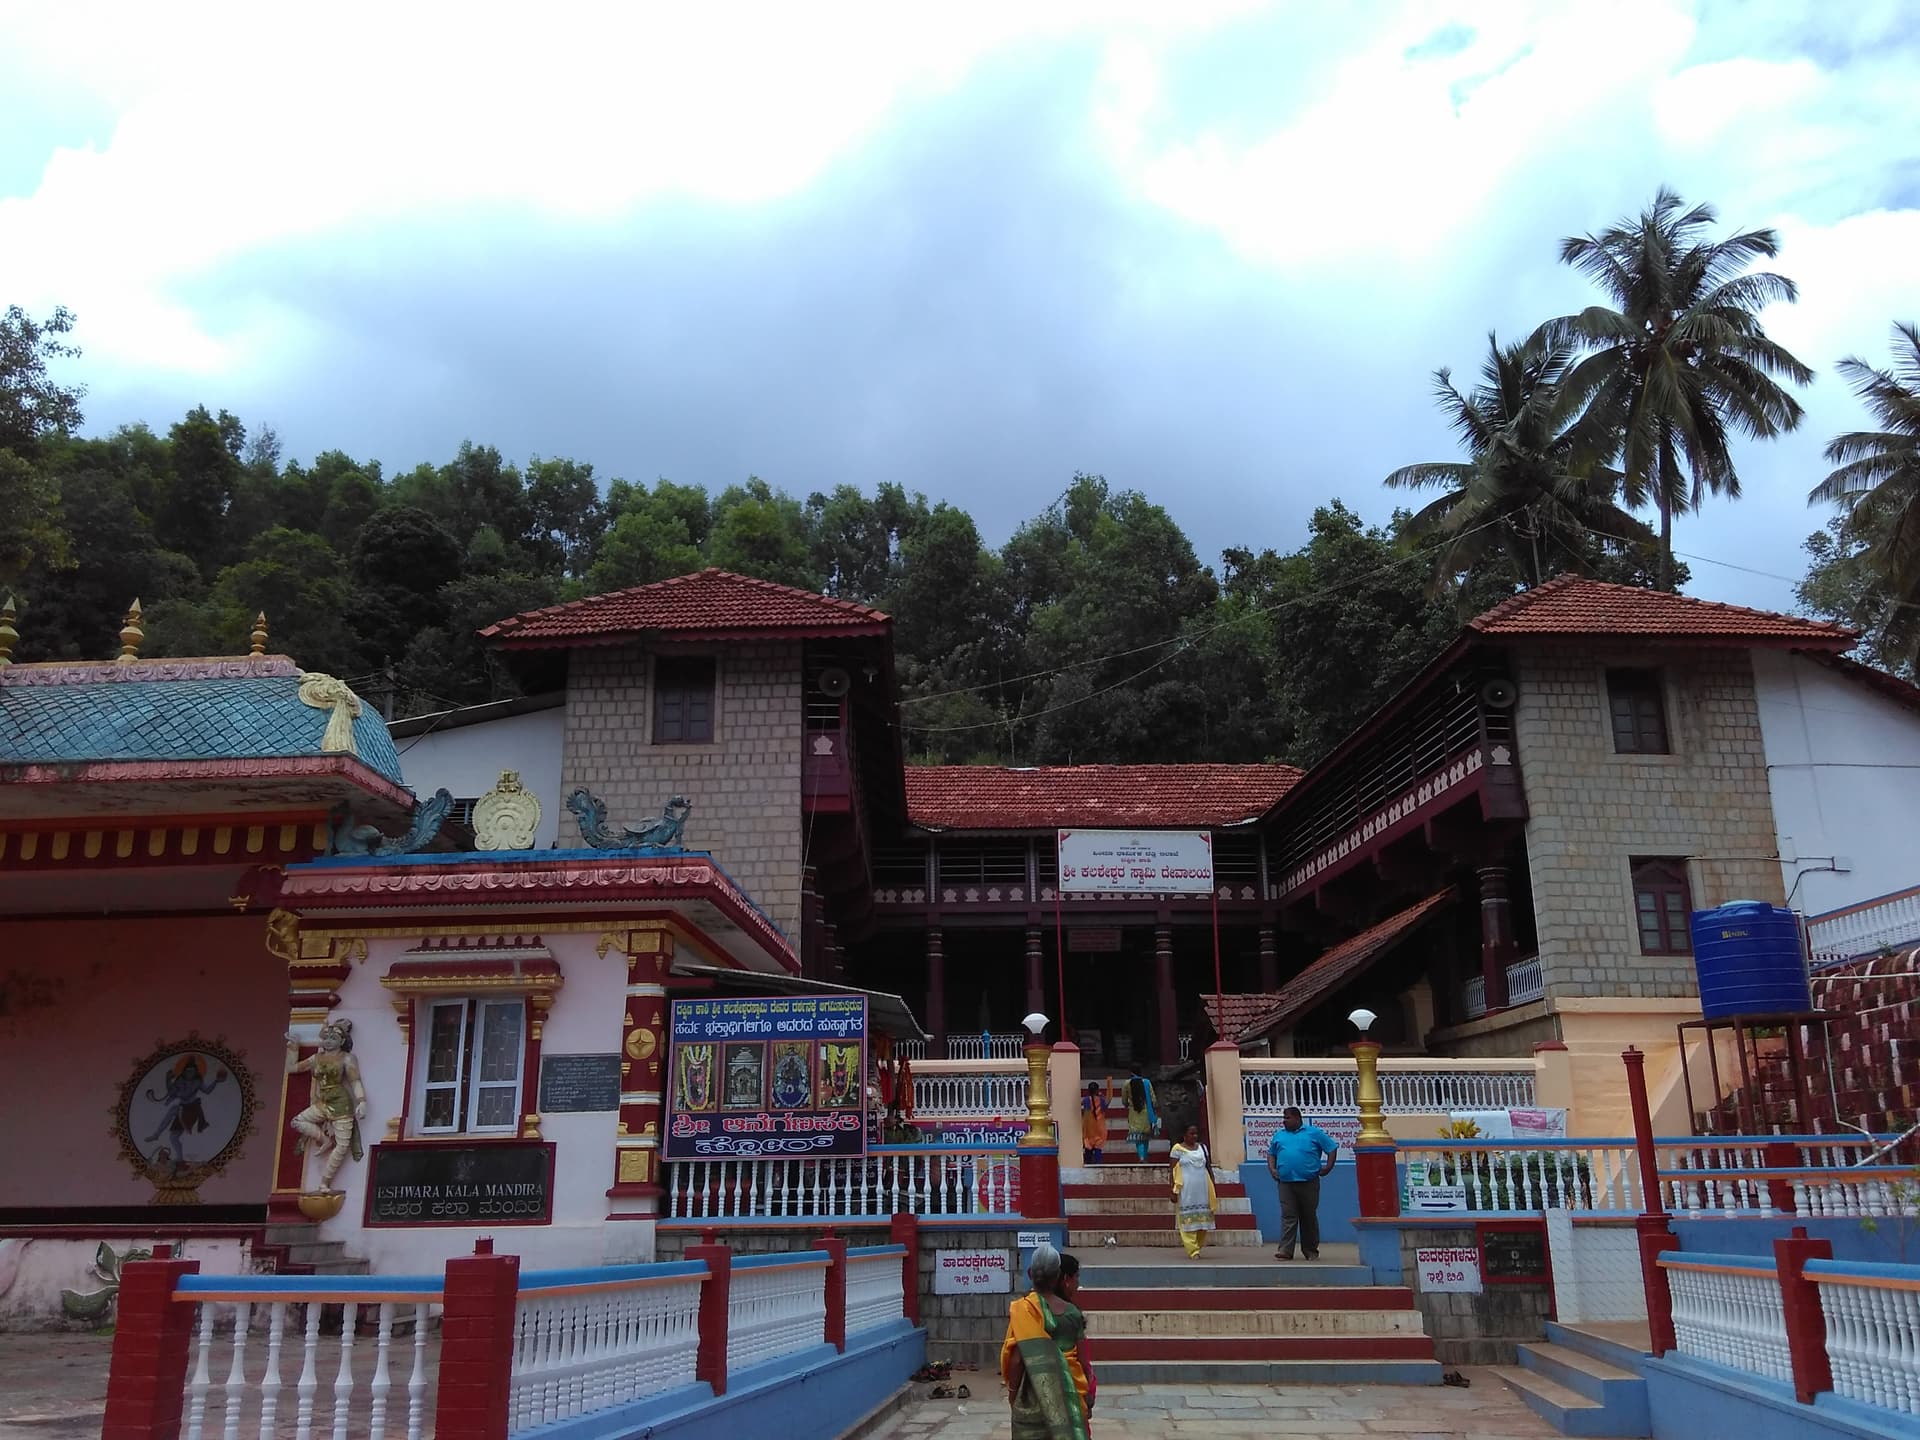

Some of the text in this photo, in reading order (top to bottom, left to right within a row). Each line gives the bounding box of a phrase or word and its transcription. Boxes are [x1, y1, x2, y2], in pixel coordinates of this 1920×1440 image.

[1063, 864, 1076, 881] ಶ್ರೀ
[1130, 866, 1156, 884] ಸ್ವಾಮಿ
[1161, 865, 1211, 879] ದೇವಾಲಯ
[675, 1021, 701, 1034] ಸರ್ವ
[777, 1018, 813, 1032] ಆದರದ
[818, 1017, 863, 1037] ಸುಸ್ವಾಗತ
[672, 1114, 710, 1137] ಶ್ರೀ
[722, 1112, 861, 1132] ಆನೆಗಣಪತಿ
[377, 1184, 543, 1199] ESHWARA KALA MANDIRA
[431, 1200, 470, 1215] ಕಲಾ
[479, 1199, 542, 1214] ಮಂದಿರ
[1427, 1270, 1444, 1284] ಇಲ್ಲಿ
